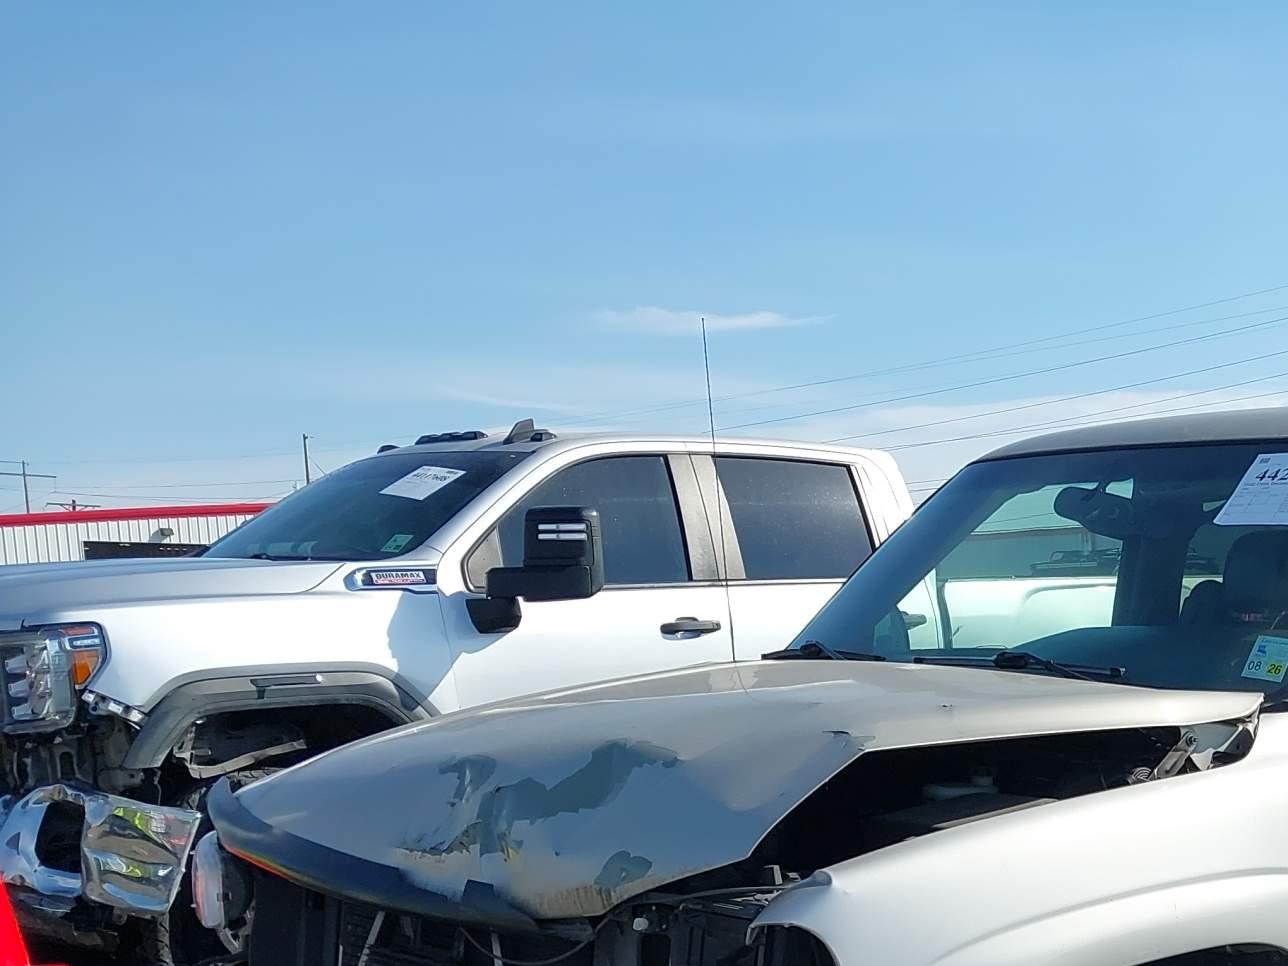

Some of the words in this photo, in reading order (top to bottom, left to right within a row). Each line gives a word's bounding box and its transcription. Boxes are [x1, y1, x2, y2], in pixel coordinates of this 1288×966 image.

[375, 571, 422, 580] DURAMAX
[1247, 660, 1262, 671] 08
[1267, 663, 1282, 675] 26
